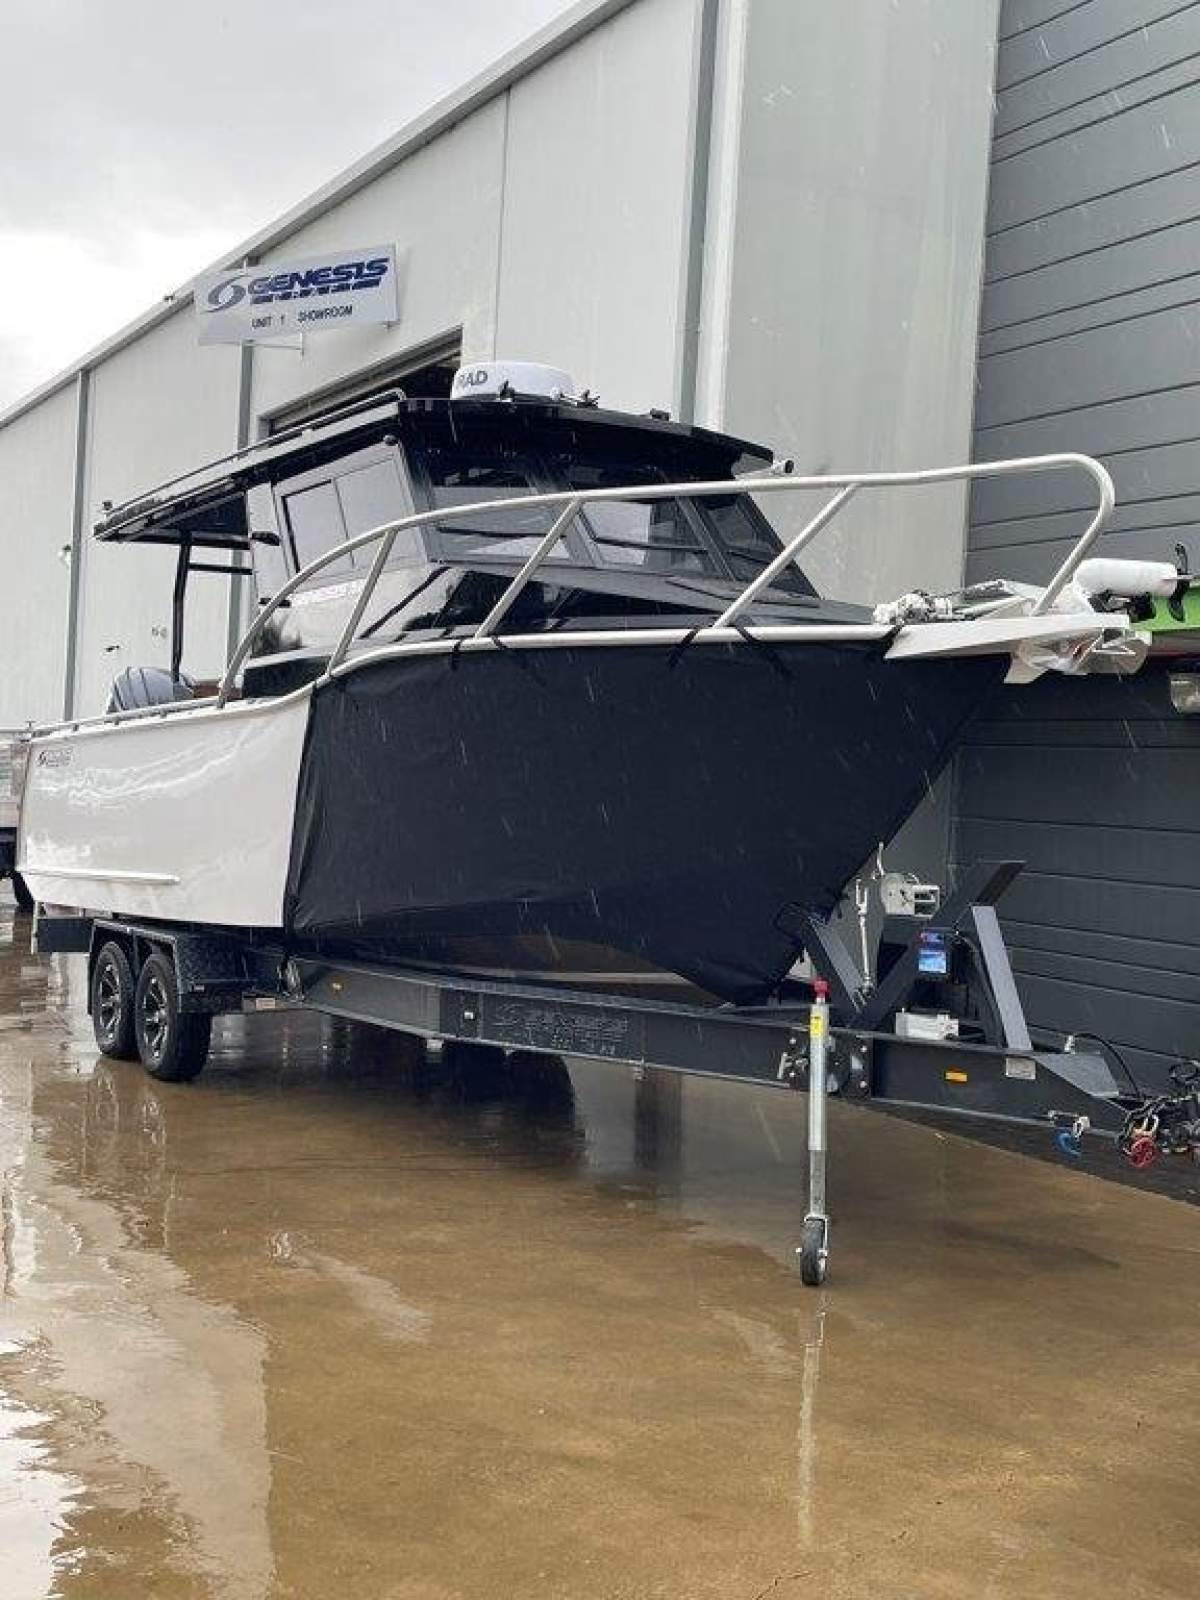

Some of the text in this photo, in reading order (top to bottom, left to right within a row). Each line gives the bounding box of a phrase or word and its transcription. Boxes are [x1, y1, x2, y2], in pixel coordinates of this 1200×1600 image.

[249, 257, 389, 294] GENESIS
[252, 315, 272, 329] UNIT
[298, 305, 352, 322] SHOWROOM
